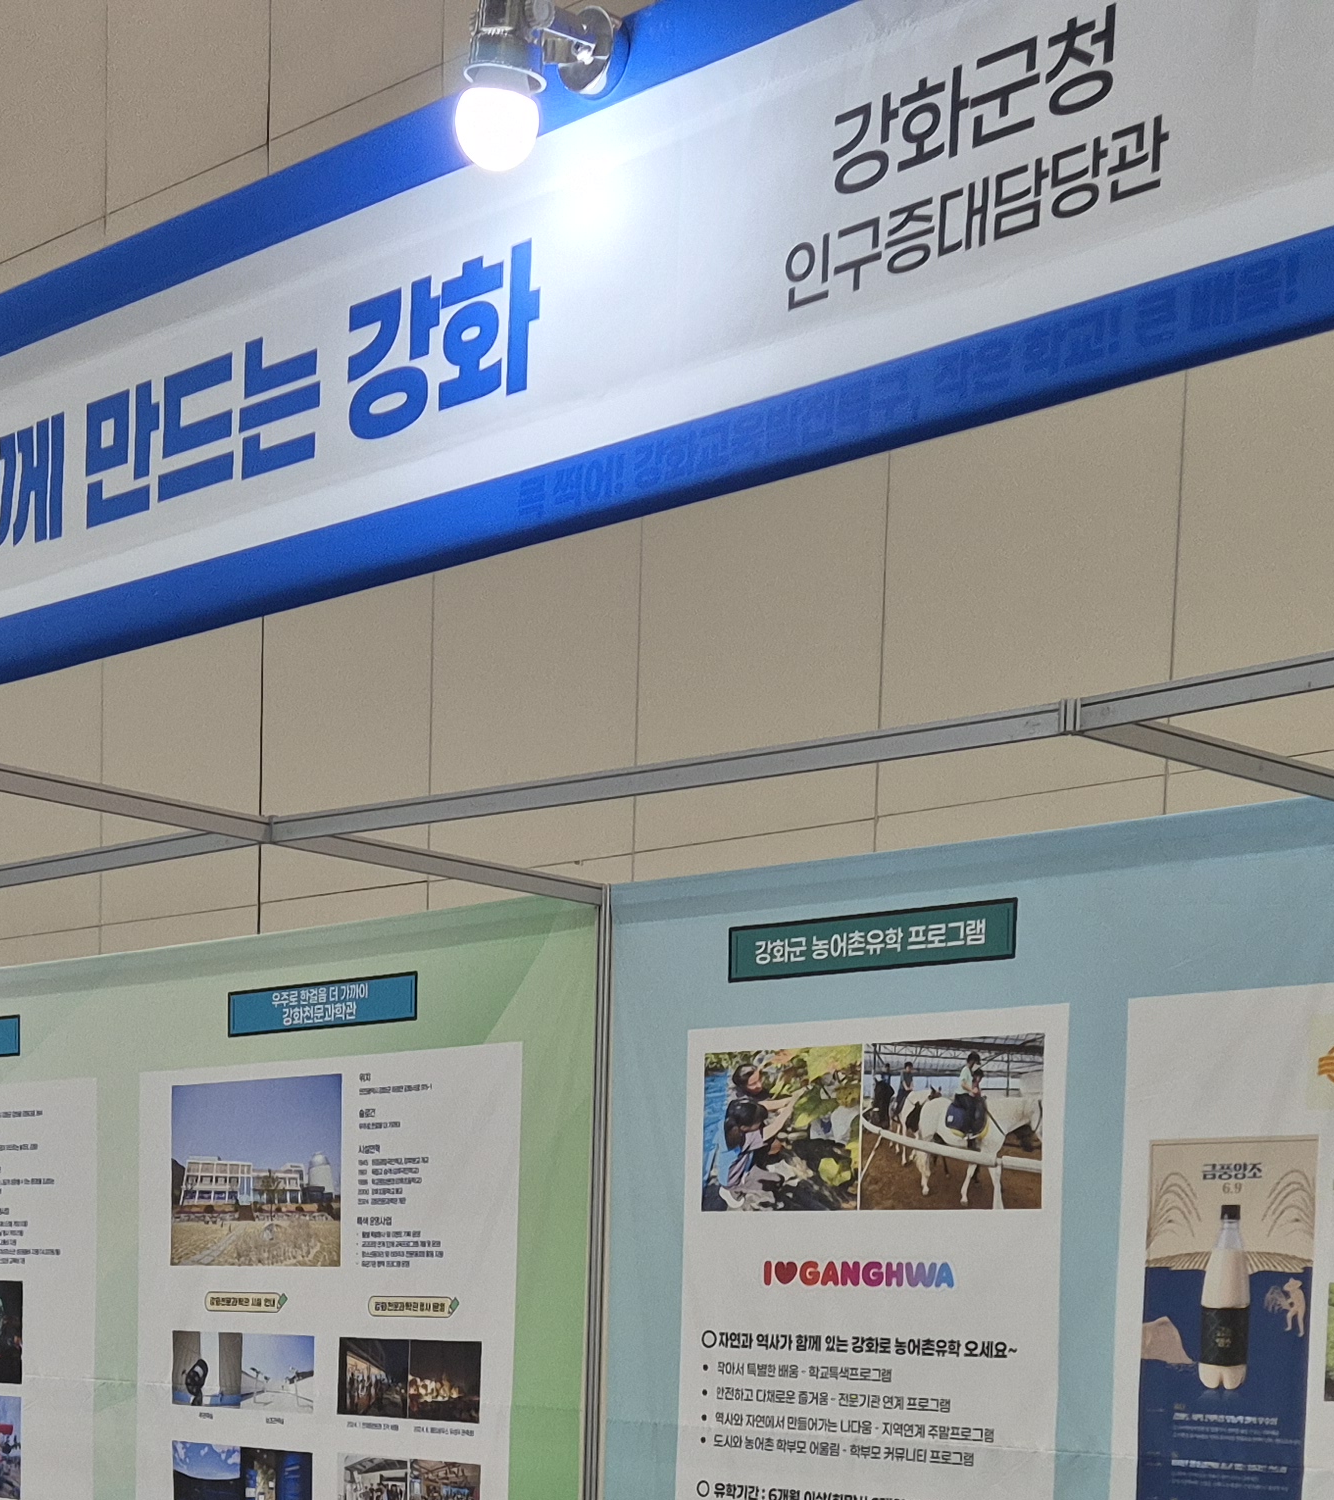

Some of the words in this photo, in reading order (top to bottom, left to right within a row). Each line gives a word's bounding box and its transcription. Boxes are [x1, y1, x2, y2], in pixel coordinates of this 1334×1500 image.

[833, 3, 1117, 195] 강화군청
[785, 114, 1170, 311] 인구증대담당관
[86, 336, 320, 529] 만드는
[347, 237, 541, 440] 강화
[755, 936, 807, 966] 강화군
[812, 927, 903, 959] 농어촌유학
[907, 918, 987, 951] 프로그램
[272, 990, 298, 1008] 우주로
[300, 986, 327, 1005] 한걸음
[329, 987, 338, 1001] 더
[341, 983, 368, 1000] 가까이
[282, 1002, 357, 1026] 강화천문과학관
[1202, 1162, 1262, 1181] 금풍양조
[1222, 1182, 1242, 1194] 6.9
[799, 1260, 955, 1289] GANGHWA
[719, 1331, 753, 1350] 자연과
[757, 1334, 792, 1351] 역사가
[796, 1334, 822, 1352] 함께
[825, 1335, 849, 1353] 있는
[852, 1336, 891, 1354] 강화로
[895, 1338, 961, 1357] 농어촌유학
[964, 1340, 1018, 1358] 오세요~
[747, 1362, 776, 1377] 특별한
[778, 1364, 799, 1379] 배움
[882, 1395, 904, 1410] 연계
[906, 1396, 951, 1413] 프로그램
[745, 1413, 785, 1429] 자연에서
[881, 1421, 926, 1438] 지역연계
[713, 1434, 742, 1448] 도시와
[776, 1439, 806, 1454] 학부모
[849, 1444, 881, 1460] 학부모
[929, 1450, 974, 1467] 프로그램
